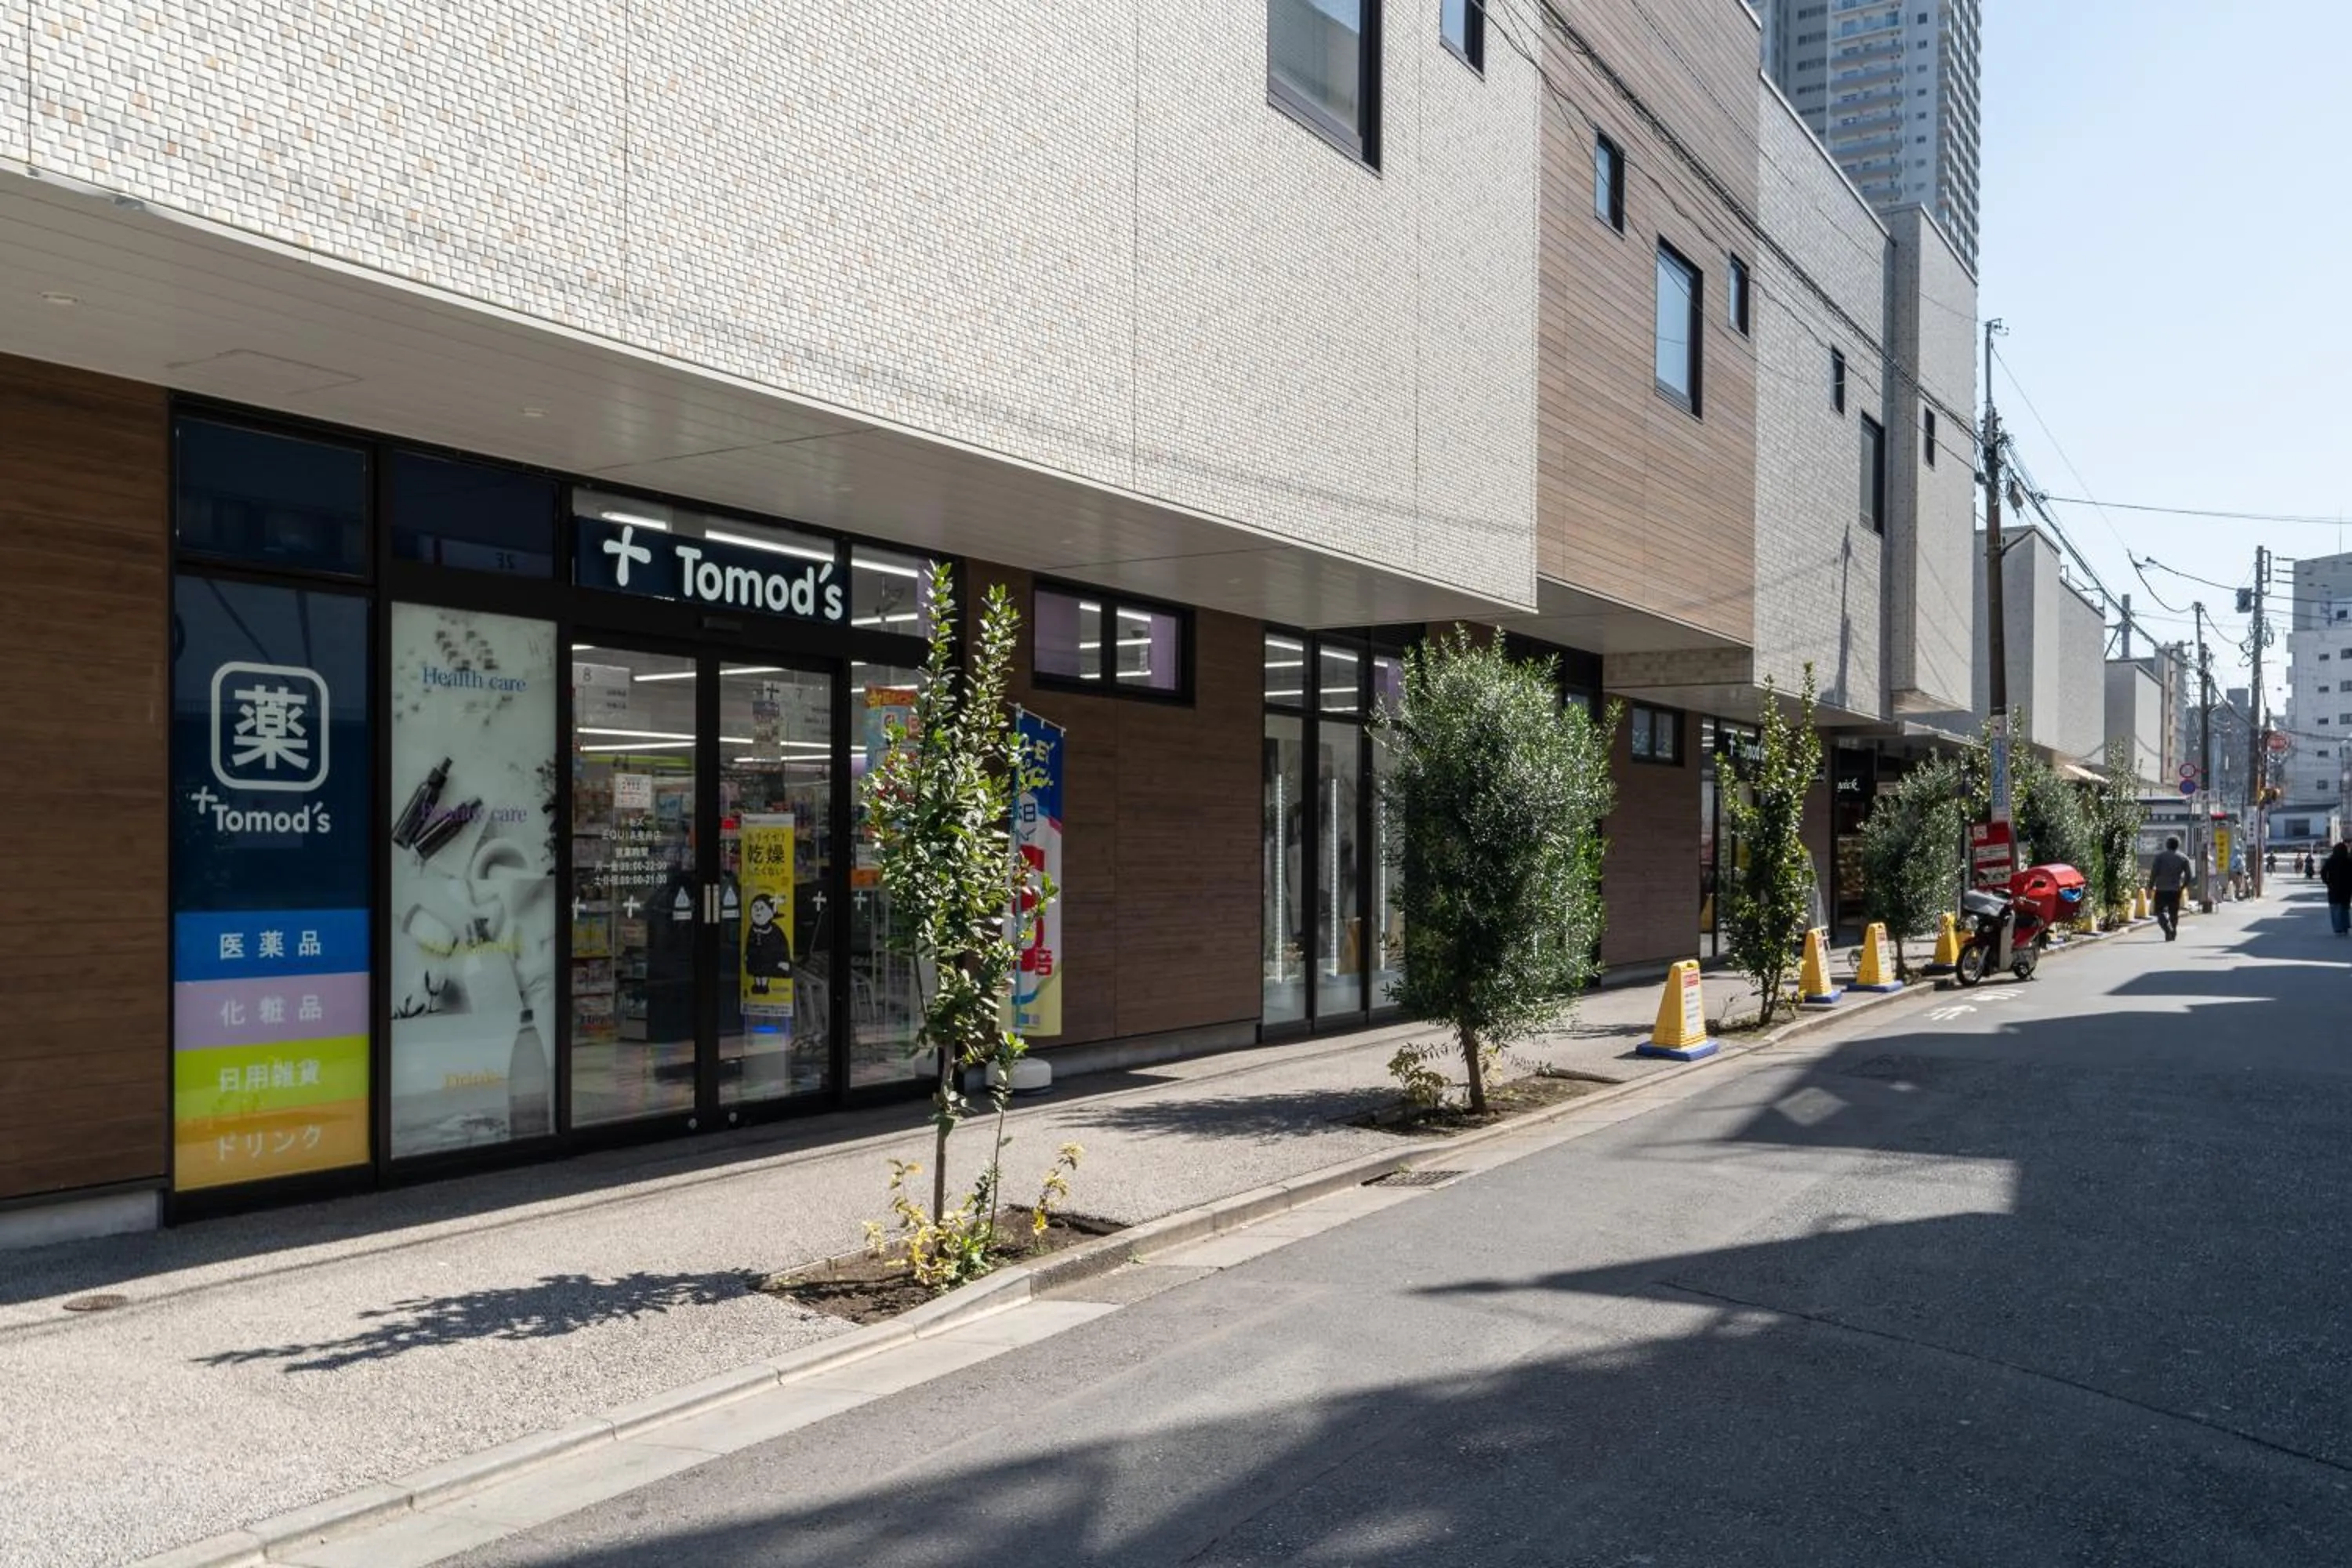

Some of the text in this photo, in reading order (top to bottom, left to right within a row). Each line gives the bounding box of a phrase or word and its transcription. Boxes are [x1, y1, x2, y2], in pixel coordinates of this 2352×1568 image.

[675, 546, 844, 621] Tomod's
[422, 665, 527, 691] Health care
[231, 684, 310, 771] 薬
[214, 800, 331, 834] Tomod's
[492, 808, 528, 823] care
[747, 843, 785, 865] 乾燥
[220, 931, 323, 961] 医薬品
[220, 994, 323, 1028] 化粧品
[218, 1058, 321, 1094] 日用雑貨
[215, 1124, 323, 1163] ドリンク
